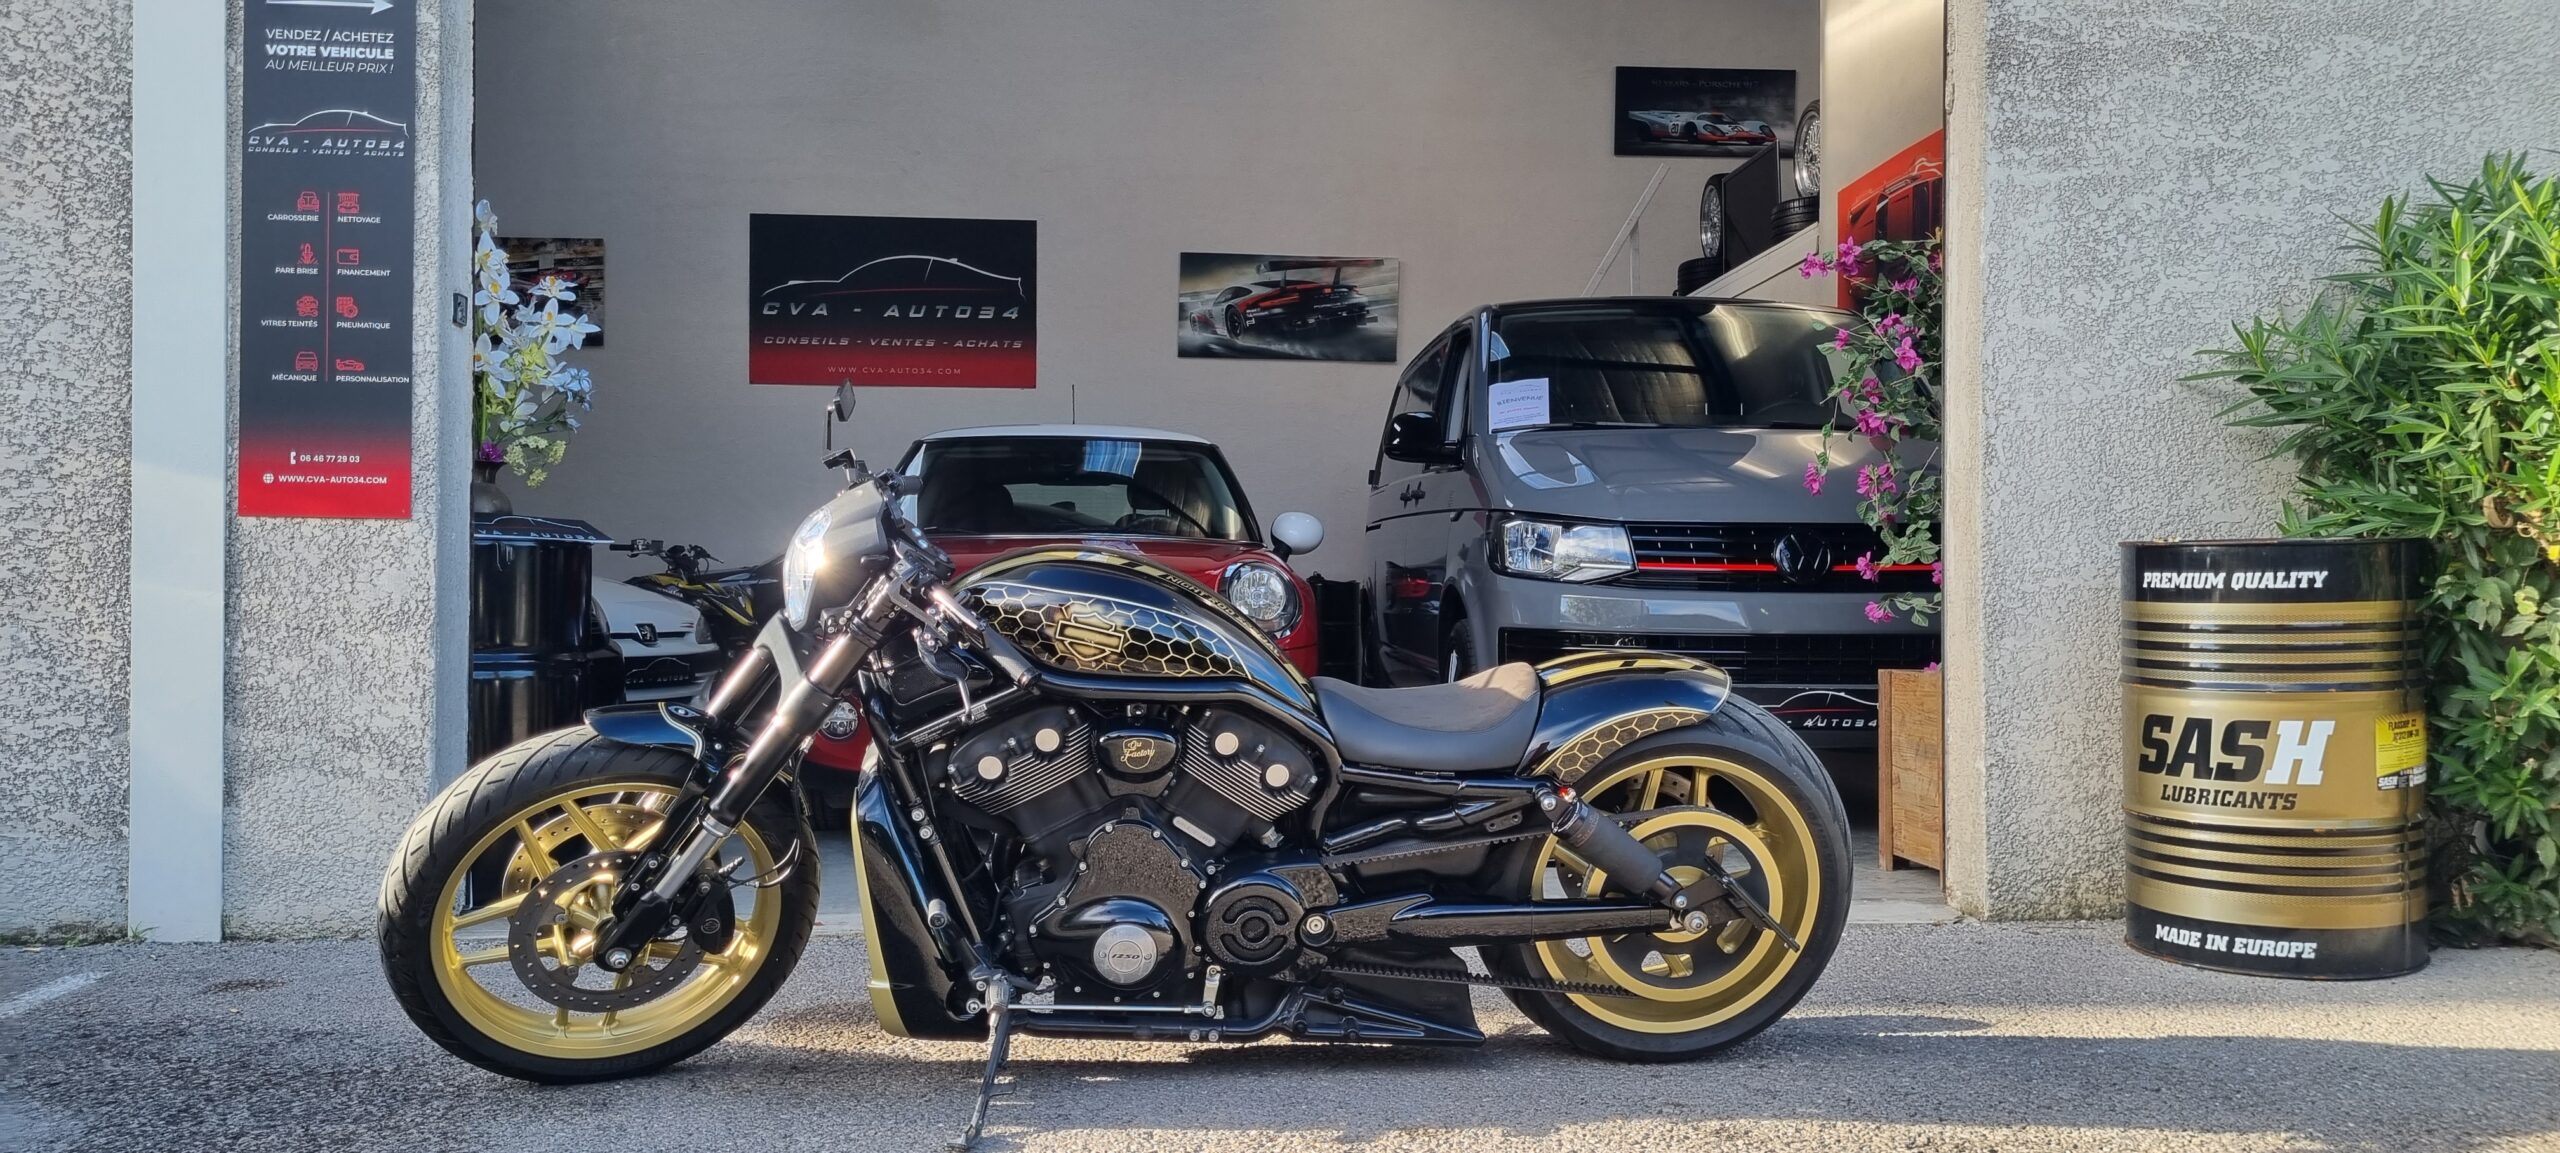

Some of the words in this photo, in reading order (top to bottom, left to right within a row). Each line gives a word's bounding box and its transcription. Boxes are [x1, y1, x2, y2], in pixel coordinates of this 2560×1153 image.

[265, 28, 321, 41] VENDEZ
[332, 31, 394, 43] ACHETEZ
[265, 44, 317, 57] VOTRE
[320, 46, 394, 60] VEHICULE
[265, 59, 285, 70] AU
[288, 60, 355, 72] MEILLEUR
[357, 62, 388, 74] PRIX
[248, 136, 289, 145] CVA
[321, 138, 405, 149] AUTO34
[267, 214, 319, 222] CARROSSERIE
[337, 216, 382, 224] NETTOYAGE
[336, 268, 391, 277] FINANCEMENT
[762, 302, 829, 317] CVA
[883, 305, 1020, 320] AUTO34
[288, 319, 318, 328] TEINTÉS
[336, 321, 391, 330] PNEUMATIQUE
[763, 336, 850, 346] CONSEILS
[870, 338, 936, 348] VENTES
[953, 340, 1024, 349] ACHATS
[272, 373, 318, 382] MÉCANIQUE
[336, 375, 410, 384] PERSONNALISATION
[299, 454, 312, 462] 06
[326, 455, 336, 463] 77
[278, 474, 388, 484] WWW.CVA-AUTO34.COM
[1166, 574, 1209, 597] NIGHT
[2143, 572, 2226, 589] PREMIUM
[2230, 571, 2328, 590] QUALITY
[1120, 748, 1156, 762] Factory
[2138, 713, 2336, 786] SASH
[2160, 784, 2298, 811] LUBRICANTS
[2155, 924, 2202, 948] MADE
[2205, 934, 2229, 952] IN
[2232, 937, 2318, 959] EUROPE
